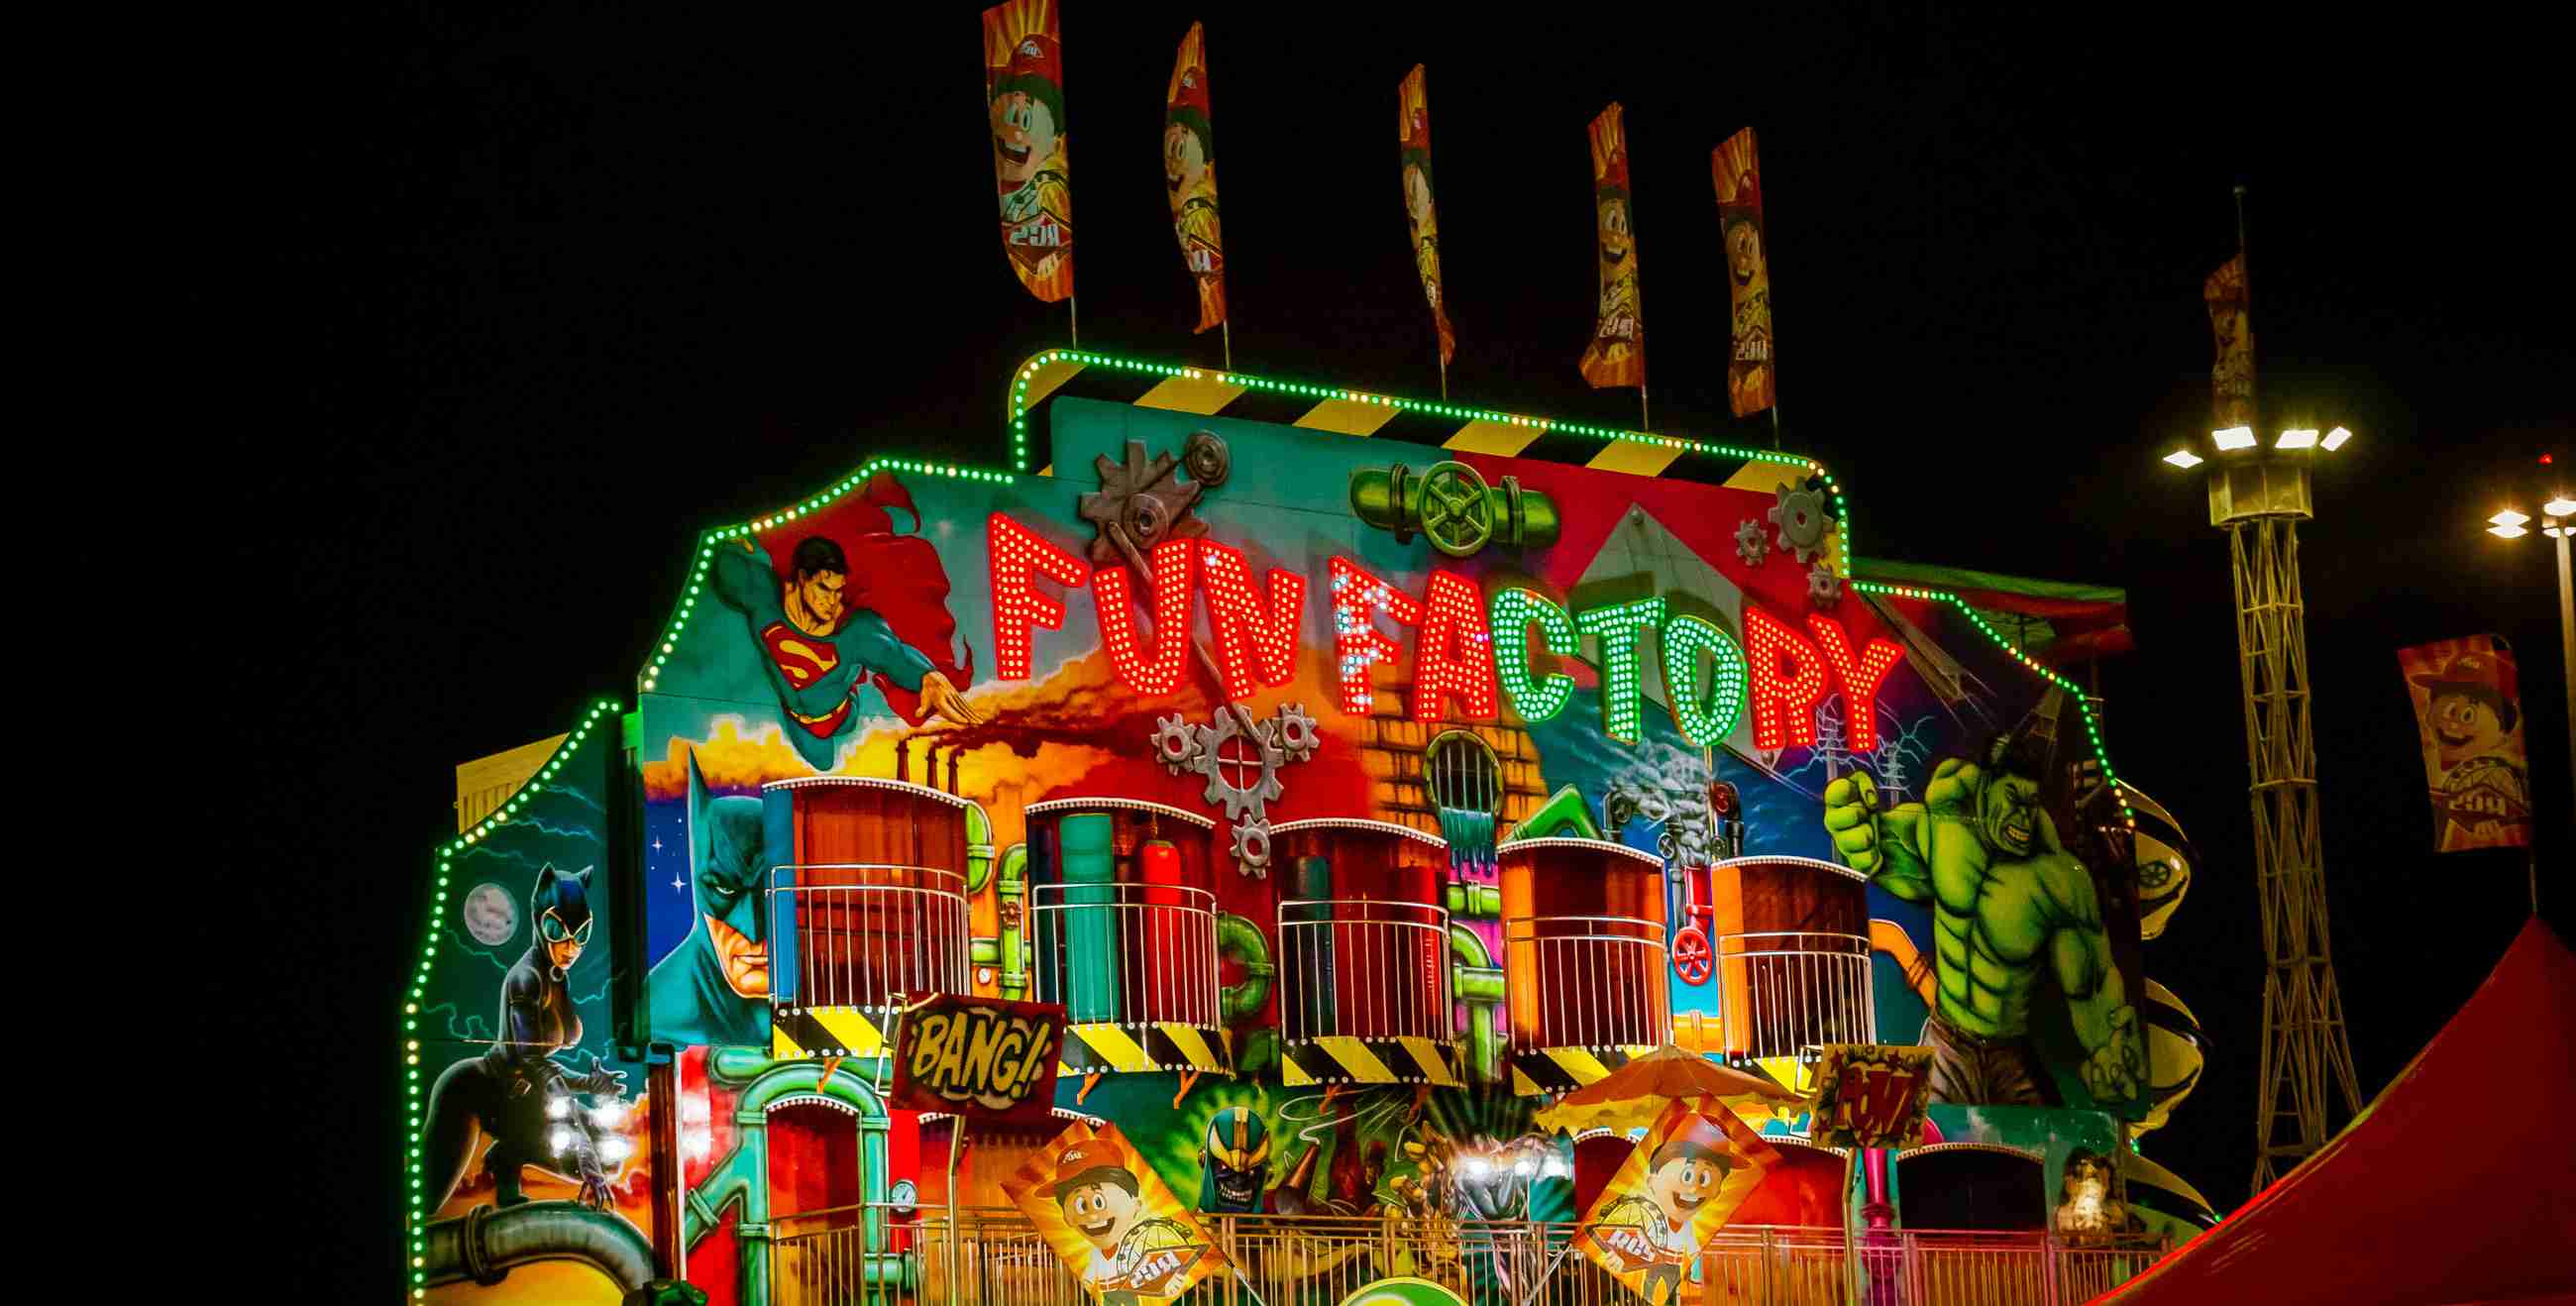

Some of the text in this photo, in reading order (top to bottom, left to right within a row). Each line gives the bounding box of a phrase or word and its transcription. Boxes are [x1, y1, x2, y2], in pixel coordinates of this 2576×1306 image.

[988, 511, 1905, 753] FUN FACTORY
[912, 1012, 1050, 1098] BANG!
